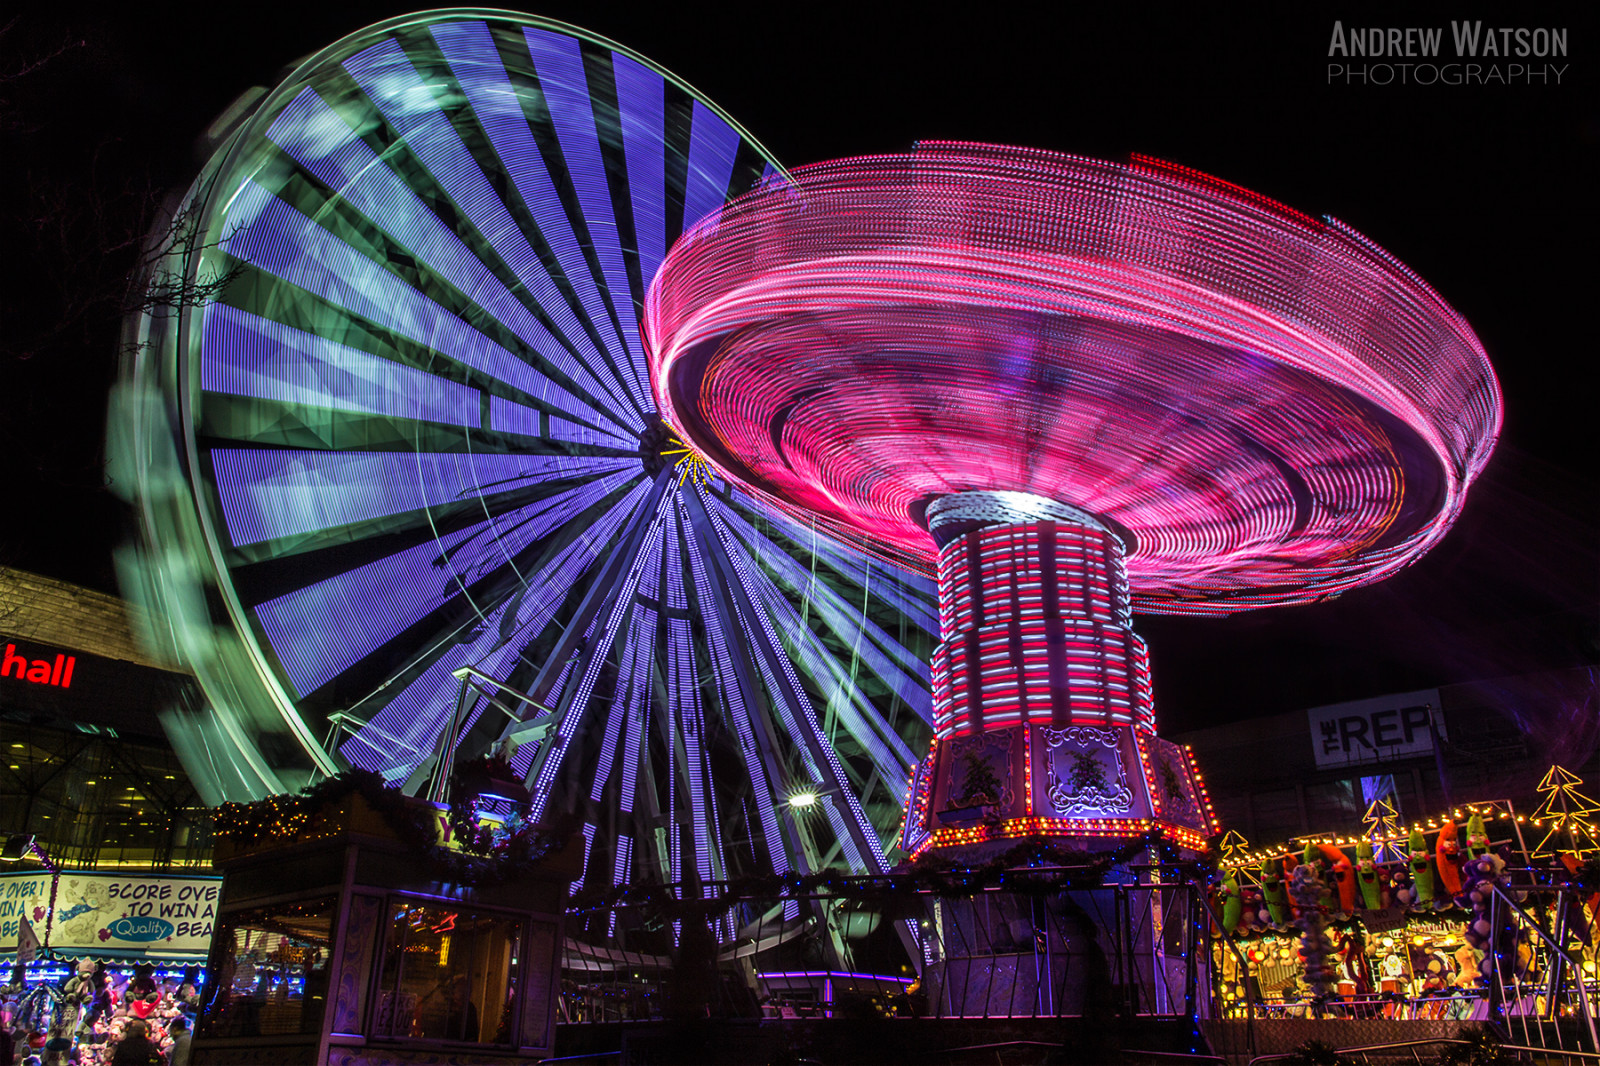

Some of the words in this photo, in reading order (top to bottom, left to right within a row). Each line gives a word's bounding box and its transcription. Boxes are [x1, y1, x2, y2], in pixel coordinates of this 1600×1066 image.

[1, 644, 76, 689] hall
[1319, 718, 1340, 755] THE
[1338, 705, 1430, 752] REP
[6, 880, 37, 898] OVER
[108, 883, 172, 900] SCORE
[178, 885, 222, 901] OVE
[0, 900, 17, 917] IN
[17, 900, 26, 917] A
[128, 902, 152, 917] TO
[159, 903, 200, 918] WIN
[201, 903, 214, 919] A
[1373, 909, 1389, 920] NO
[116, 919, 168, 941] Quality
[1368, 919, 1402, 931] ENTRY
